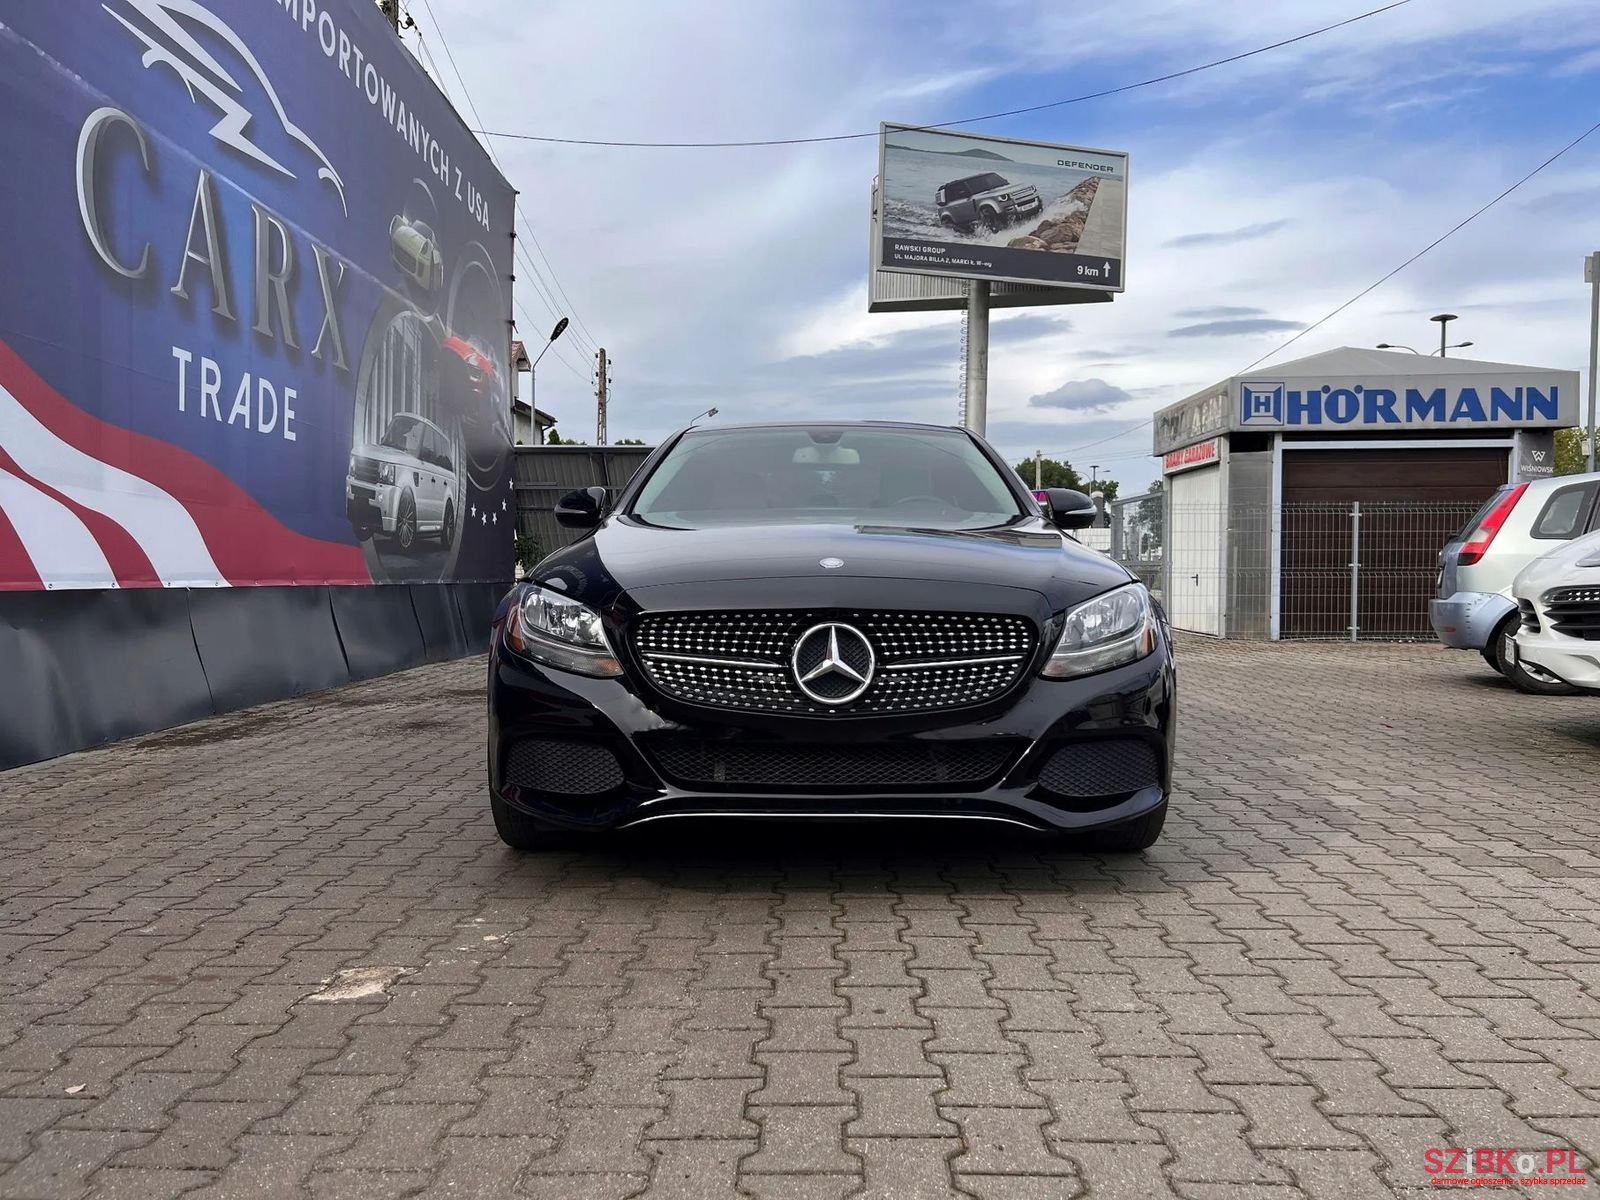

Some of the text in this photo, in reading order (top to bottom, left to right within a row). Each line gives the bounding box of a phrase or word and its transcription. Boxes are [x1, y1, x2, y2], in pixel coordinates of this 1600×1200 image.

[1057, 159, 1114, 173] DEFENDER
[454, 166, 462, 201] Z
[467, 181, 490, 232] USA
[76, 106, 350, 371] CARX
[894, 243, 946, 254] RAWSKI GROUP
[904, 254, 928, 262] MAJORA
[1077, 265, 1099, 277] 9 km
[172, 346, 297, 441] TRADE
[1287, 384, 1558, 425] HÖRMANN
